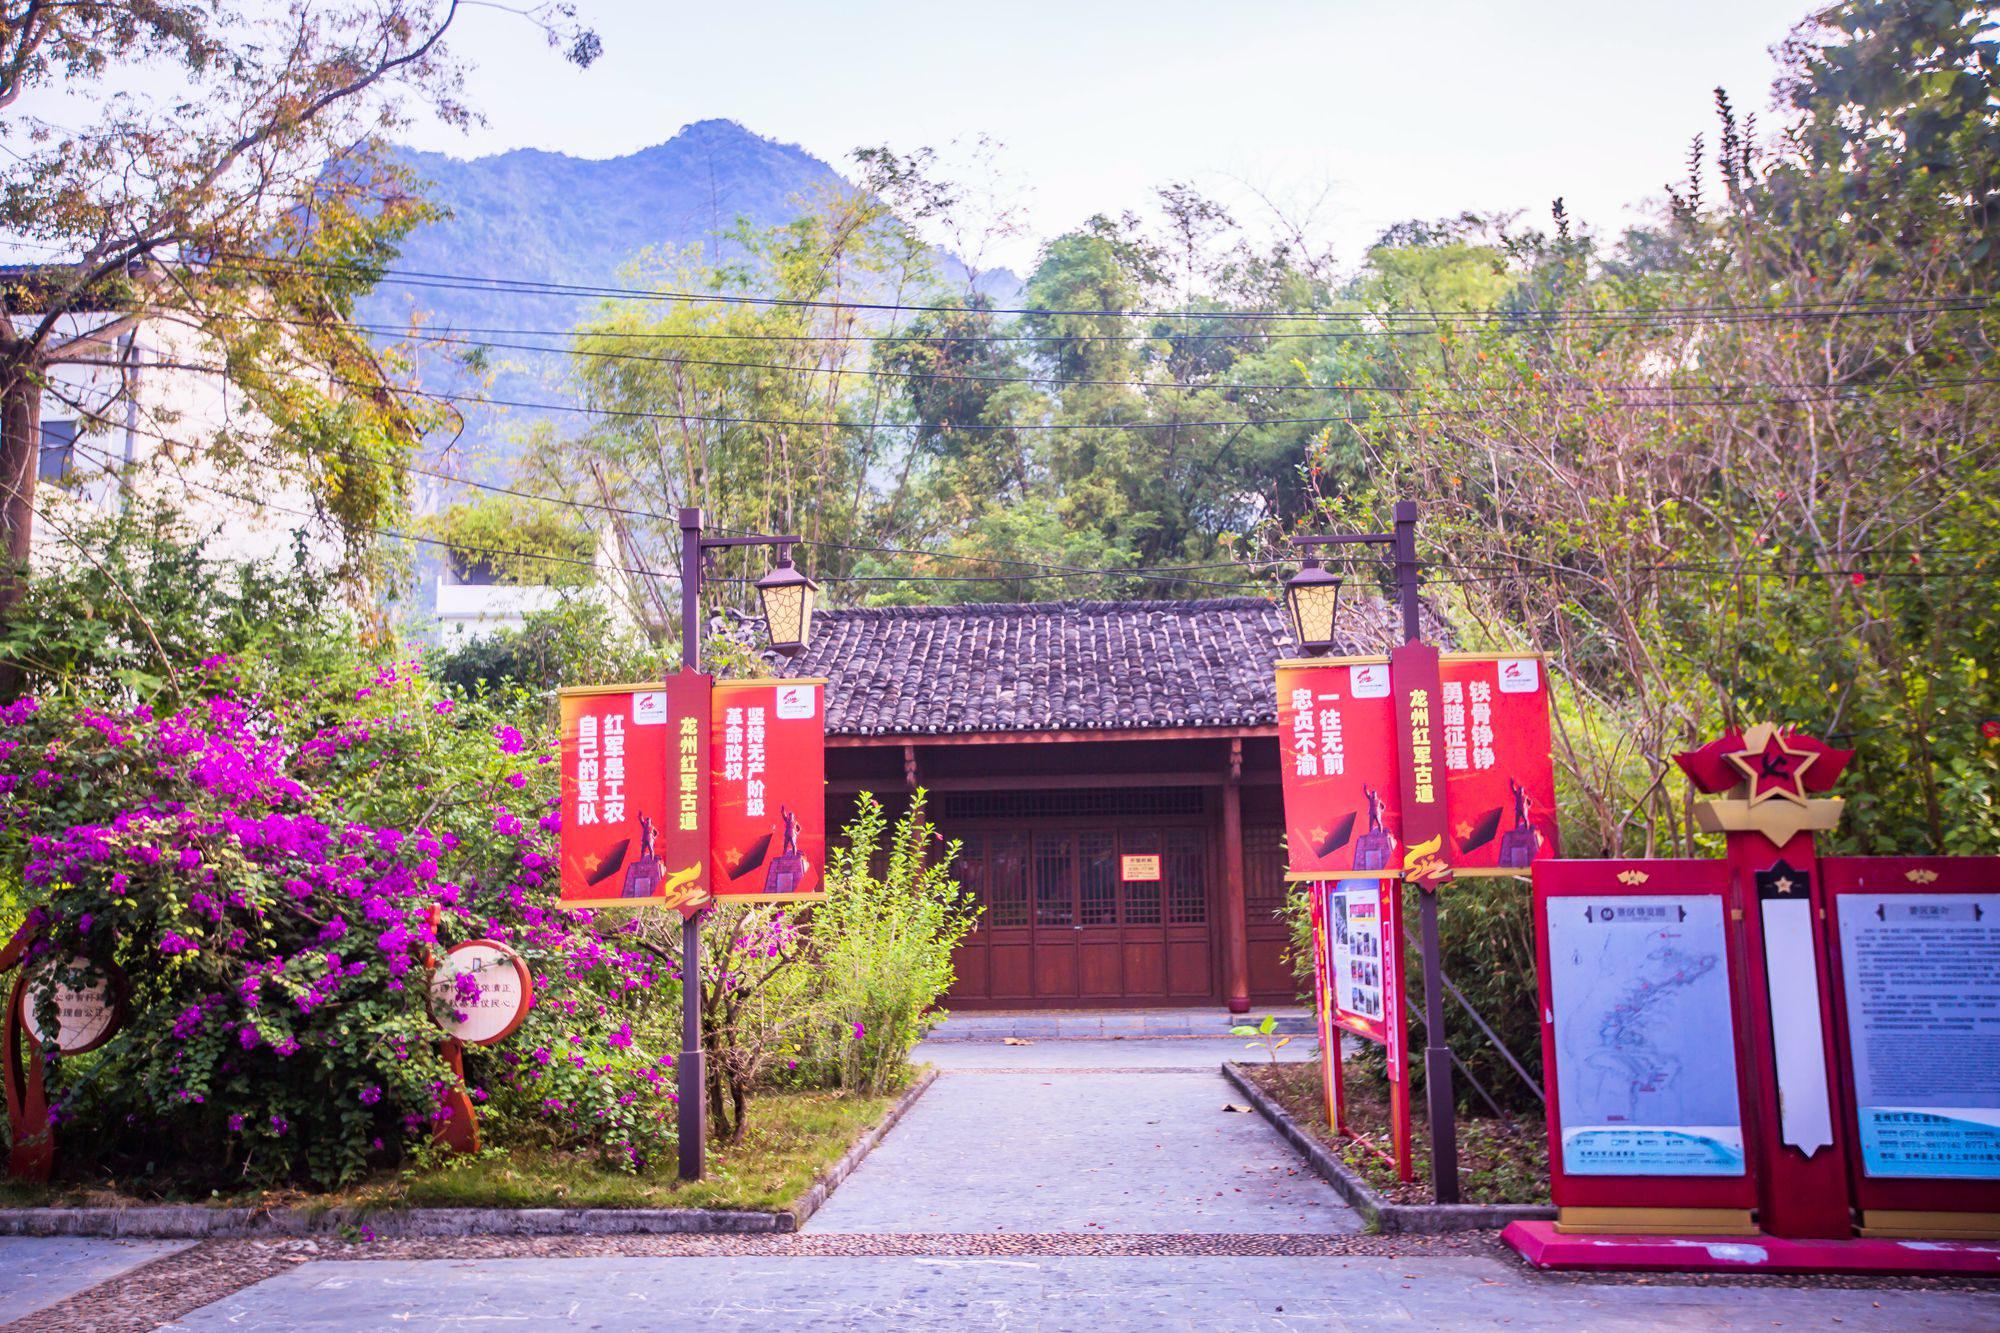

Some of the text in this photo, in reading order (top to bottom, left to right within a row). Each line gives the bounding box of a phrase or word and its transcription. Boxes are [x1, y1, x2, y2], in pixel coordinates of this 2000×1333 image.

[578, 715, 599, 825] 自己的军队
[603, 714, 625, 824] 红军是工农
[679, 716, 698, 831] 龙州红军古道
[725, 707, 743, 781] 革命政权
[746, 707, 765, 817] 坚持无产阶级
[1291, 688, 1318, 777] 忠贞不渝
[1318, 693, 1345, 775] 一往无前
[1409, 689, 1435, 804] 龙州红军古道
[1442, 681, 1469, 770] 勇踏征程
[1469, 680, 1495, 770] 铁骨铮铮
